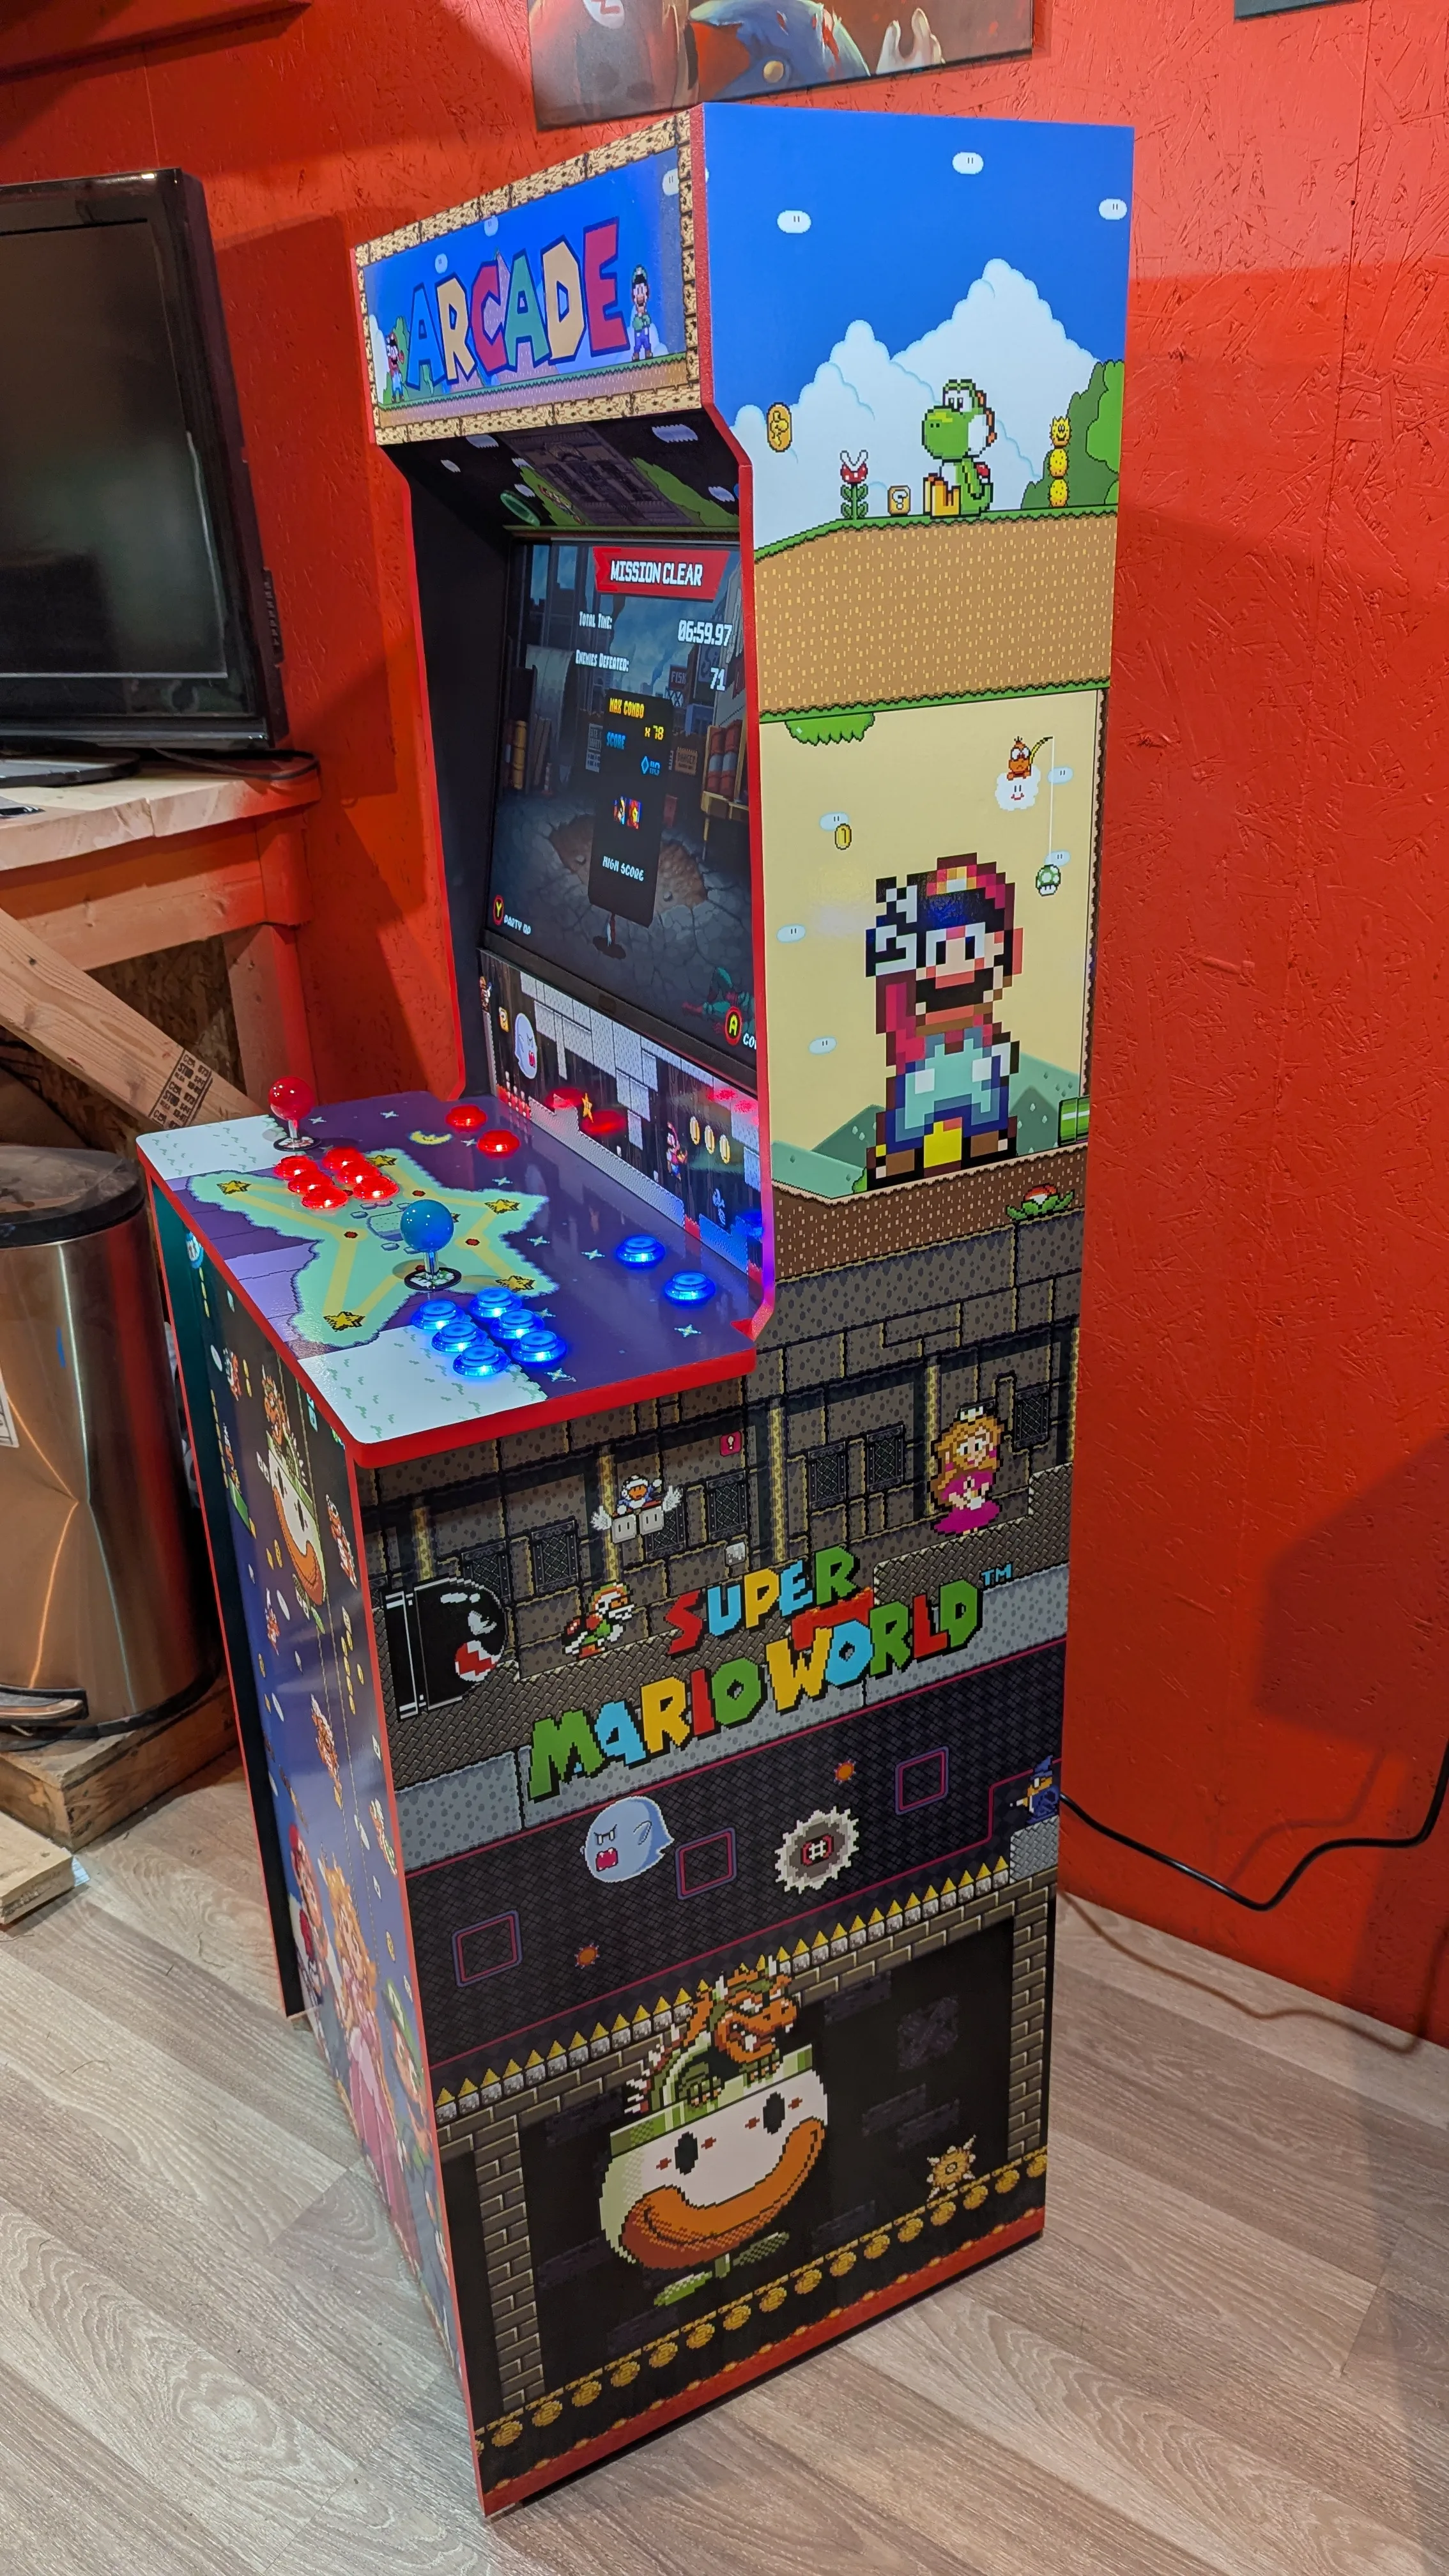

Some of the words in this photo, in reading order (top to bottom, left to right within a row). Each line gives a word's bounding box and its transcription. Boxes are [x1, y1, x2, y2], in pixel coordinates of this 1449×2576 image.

[406, 217, 631, 389] ARCADE
[611, 560, 661, 583] MISSION
[663, 562, 703, 586] CLEAR
[678, 620, 732, 647] 06:59.97
[710, 668, 726, 691] 71
[610, 697, 622, 714] MAX
[624, 700, 645, 719] COMBO
[606, 731, 625, 750] SCORE
[653, 724, 664, 740] 78
[602, 855, 619, 873] HIGH
[620, 862, 644, 882] SCORE
[496, 900, 502, 917] Y
[503, 914, 522, 931] PARTY
[729, 1014, 738, 1036] A
[665, 1545, 860, 1656] SUPER
[528, 1657, 766, 1802] MARIO
[766, 1579, 983, 1713] WORLD
